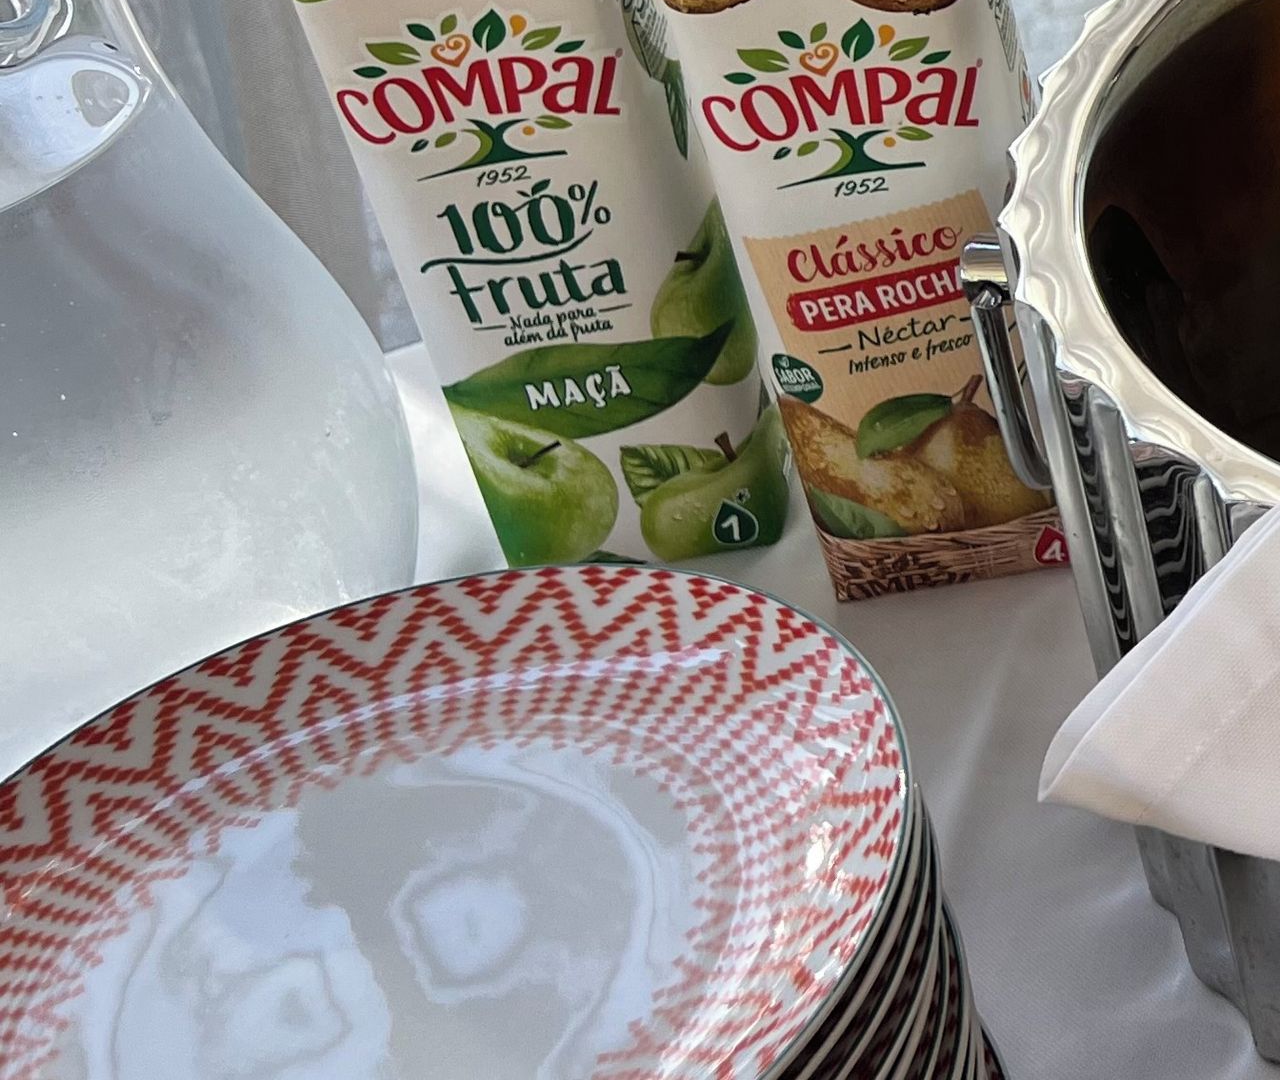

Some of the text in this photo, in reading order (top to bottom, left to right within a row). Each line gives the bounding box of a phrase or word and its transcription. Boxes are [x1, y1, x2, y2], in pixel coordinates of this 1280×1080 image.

[475, 165, 532, 187] 1952
[834, 176, 889, 198] 1952
[436, 180, 612, 256] 100%
[787, 225, 964, 283] Clássico
[556, 307, 597, 328] para
[800, 290, 875, 325] PERA
[503, 329, 544, 346] além
[546, 320, 569, 340] da
[858, 314, 956, 351] Néctar
[848, 332, 974, 375] Intenso e fresco
[524, 364, 632, 411] MAÇÃ
[721, 515, 741, 541] 1
[1045, 541, 1066, 562] 4
